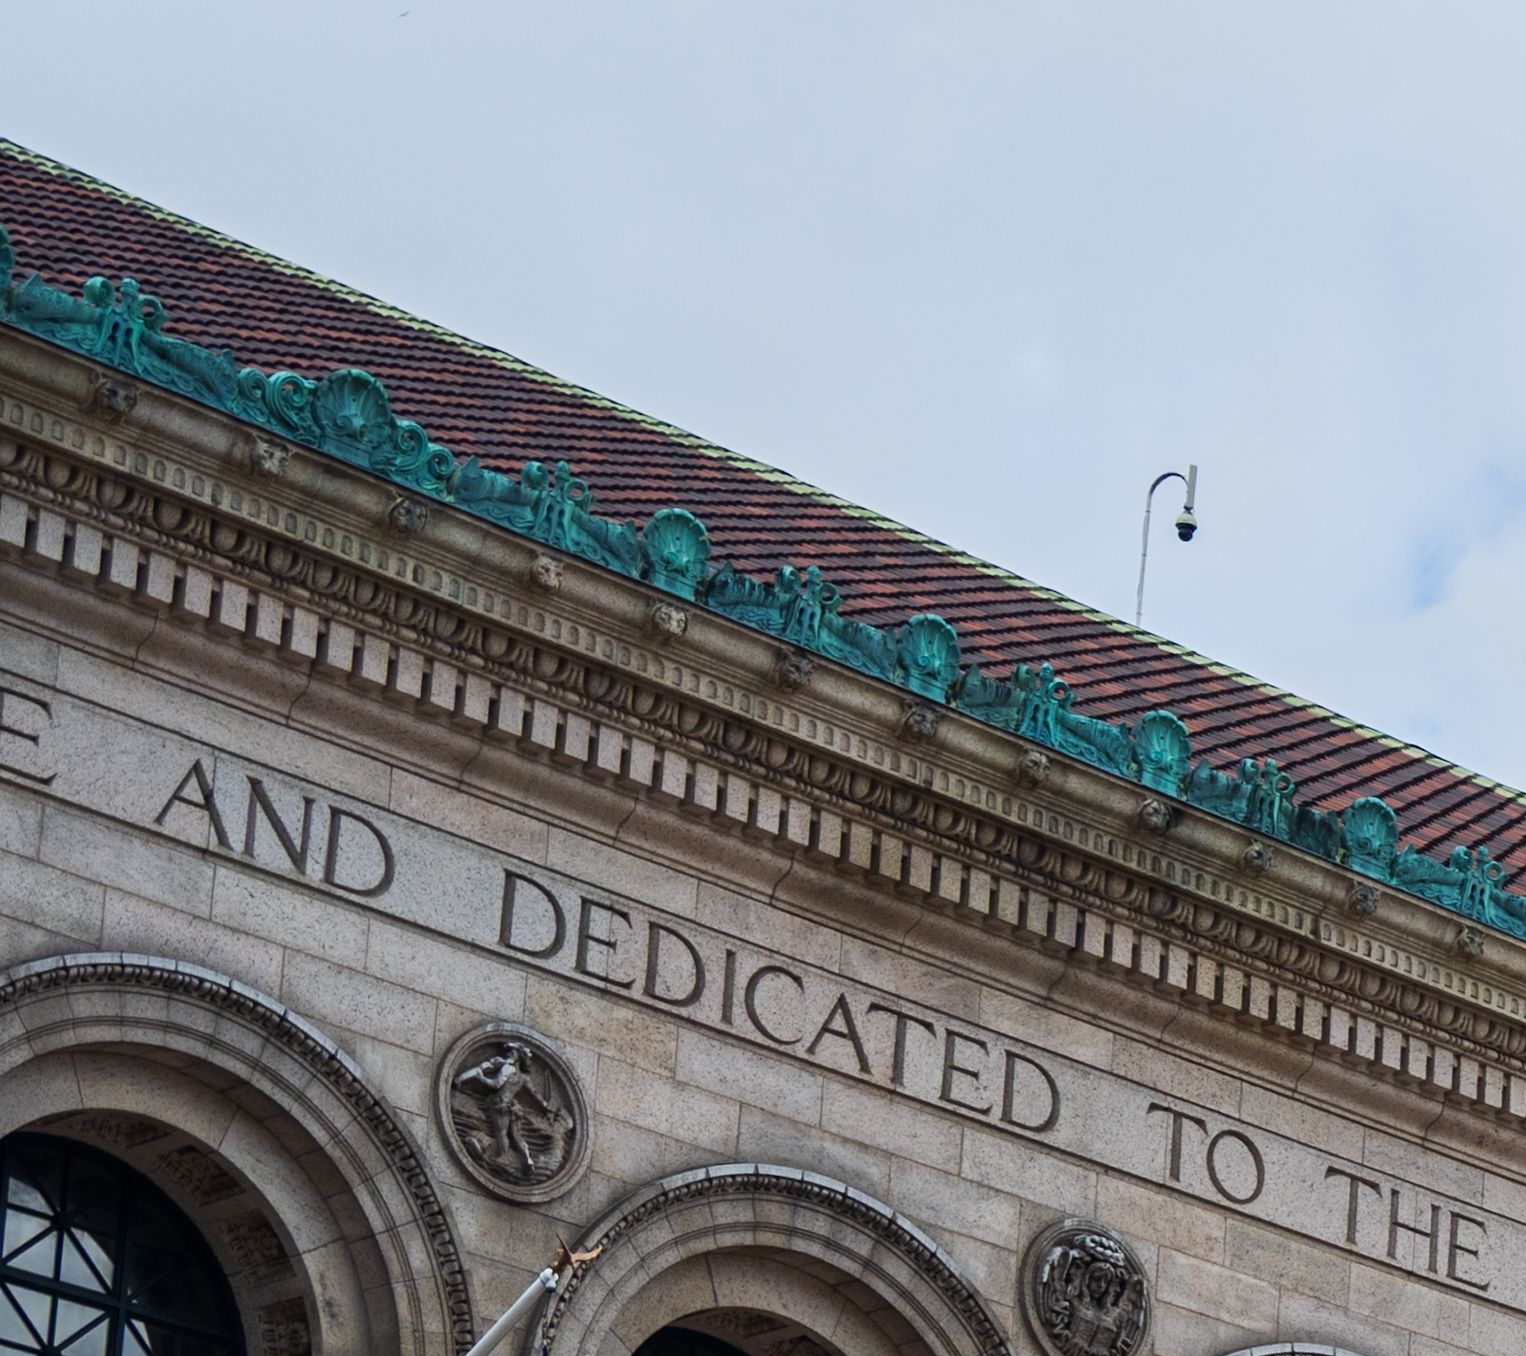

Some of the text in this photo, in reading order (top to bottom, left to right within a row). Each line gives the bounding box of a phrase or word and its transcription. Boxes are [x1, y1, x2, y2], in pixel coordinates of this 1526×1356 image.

[0, 686, 57, 787] E
[156, 759, 396, 898] AND
[498, 868, 1061, 1133] DEDICATED
[1146, 1103, 1264, 1206] TO
[1325, 1166, 1490, 1290] THE
